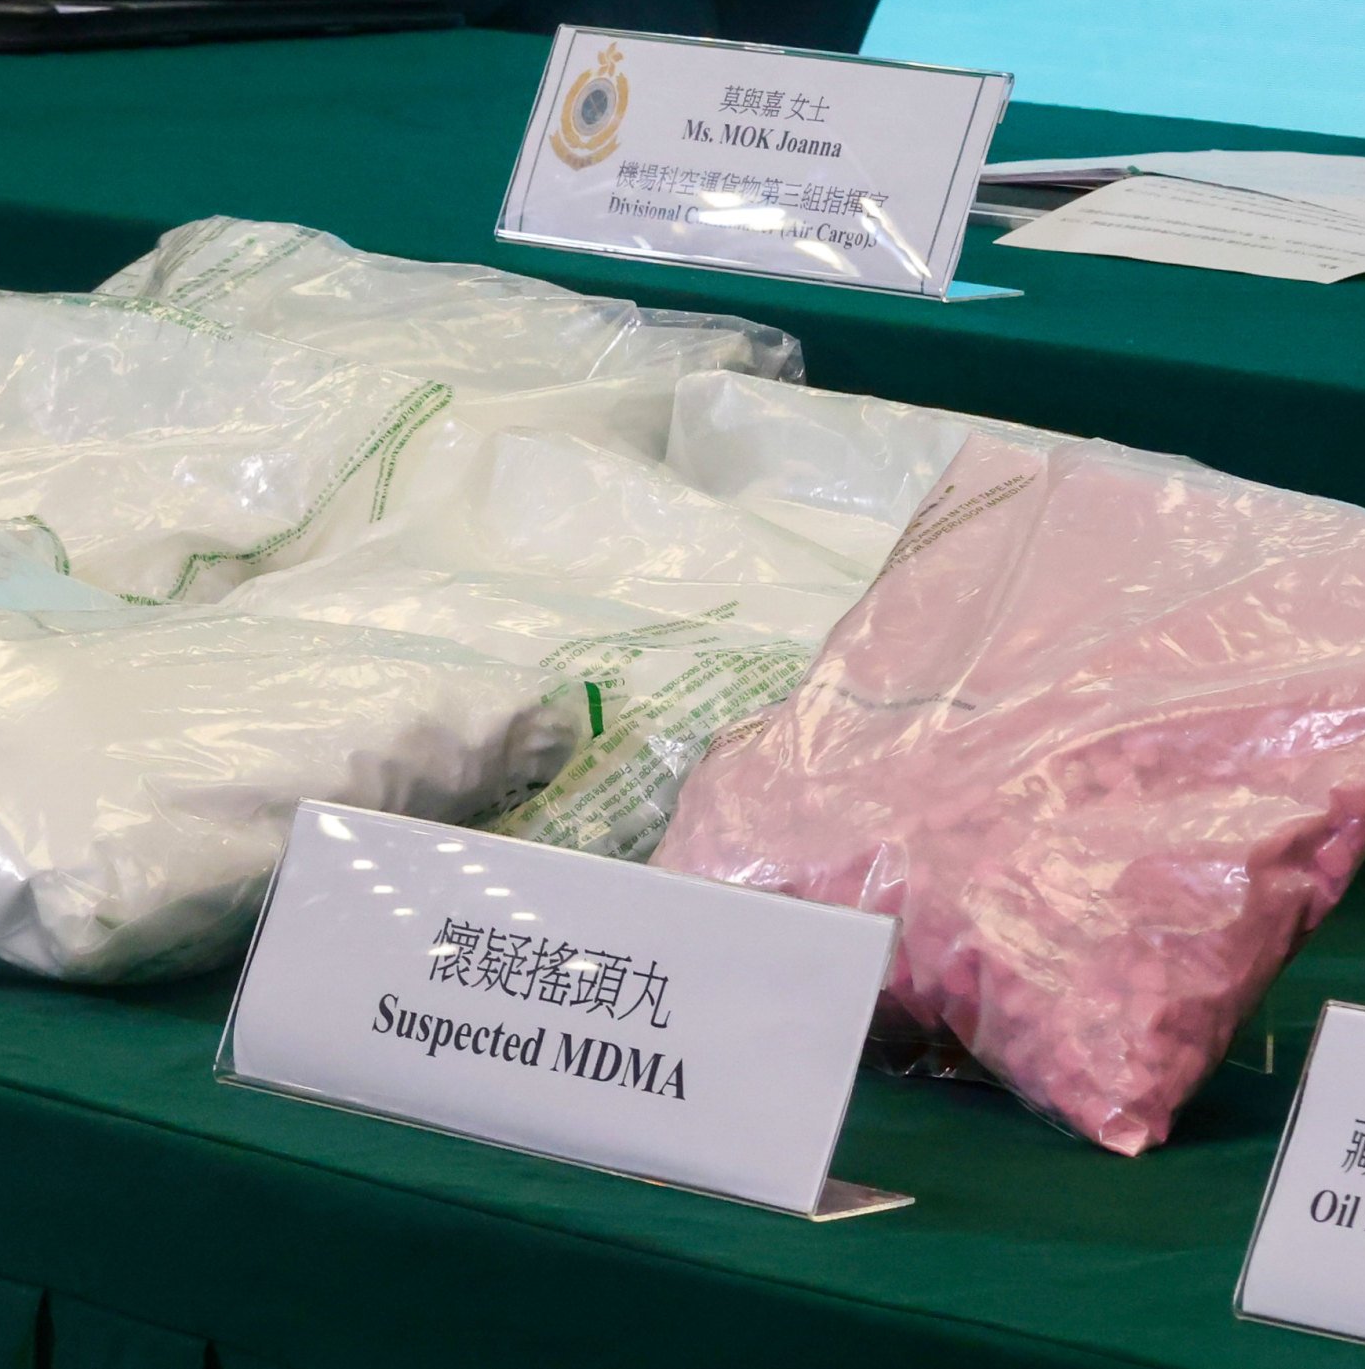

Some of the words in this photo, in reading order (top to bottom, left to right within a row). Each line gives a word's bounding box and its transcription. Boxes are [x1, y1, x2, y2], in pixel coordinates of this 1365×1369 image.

[718, 84, 786, 120] 莫與嘉
[785, 93, 831, 124] 女士
[682, 118, 714, 145] Ms.
[719, 121, 771, 151] MOK
[775, 129, 844, 159] Joanna
[607, 191, 683, 222] Divisional
[979, 483, 1005, 501] TAPE
[924, 505, 985, 546] SUPERVISOR
[537, 650, 560, 669] AND
[699, 656, 715, 671] 30
[661, 664, 701, 695] seconds
[617, 775, 641, 797] tape
[429, 916, 673, 1030] 懷疑搖頭丸
[371, 991, 546, 1068] Suspected
[551, 1032, 689, 1102] MDMA
[1309, 1187, 1361, 1227] Oil
